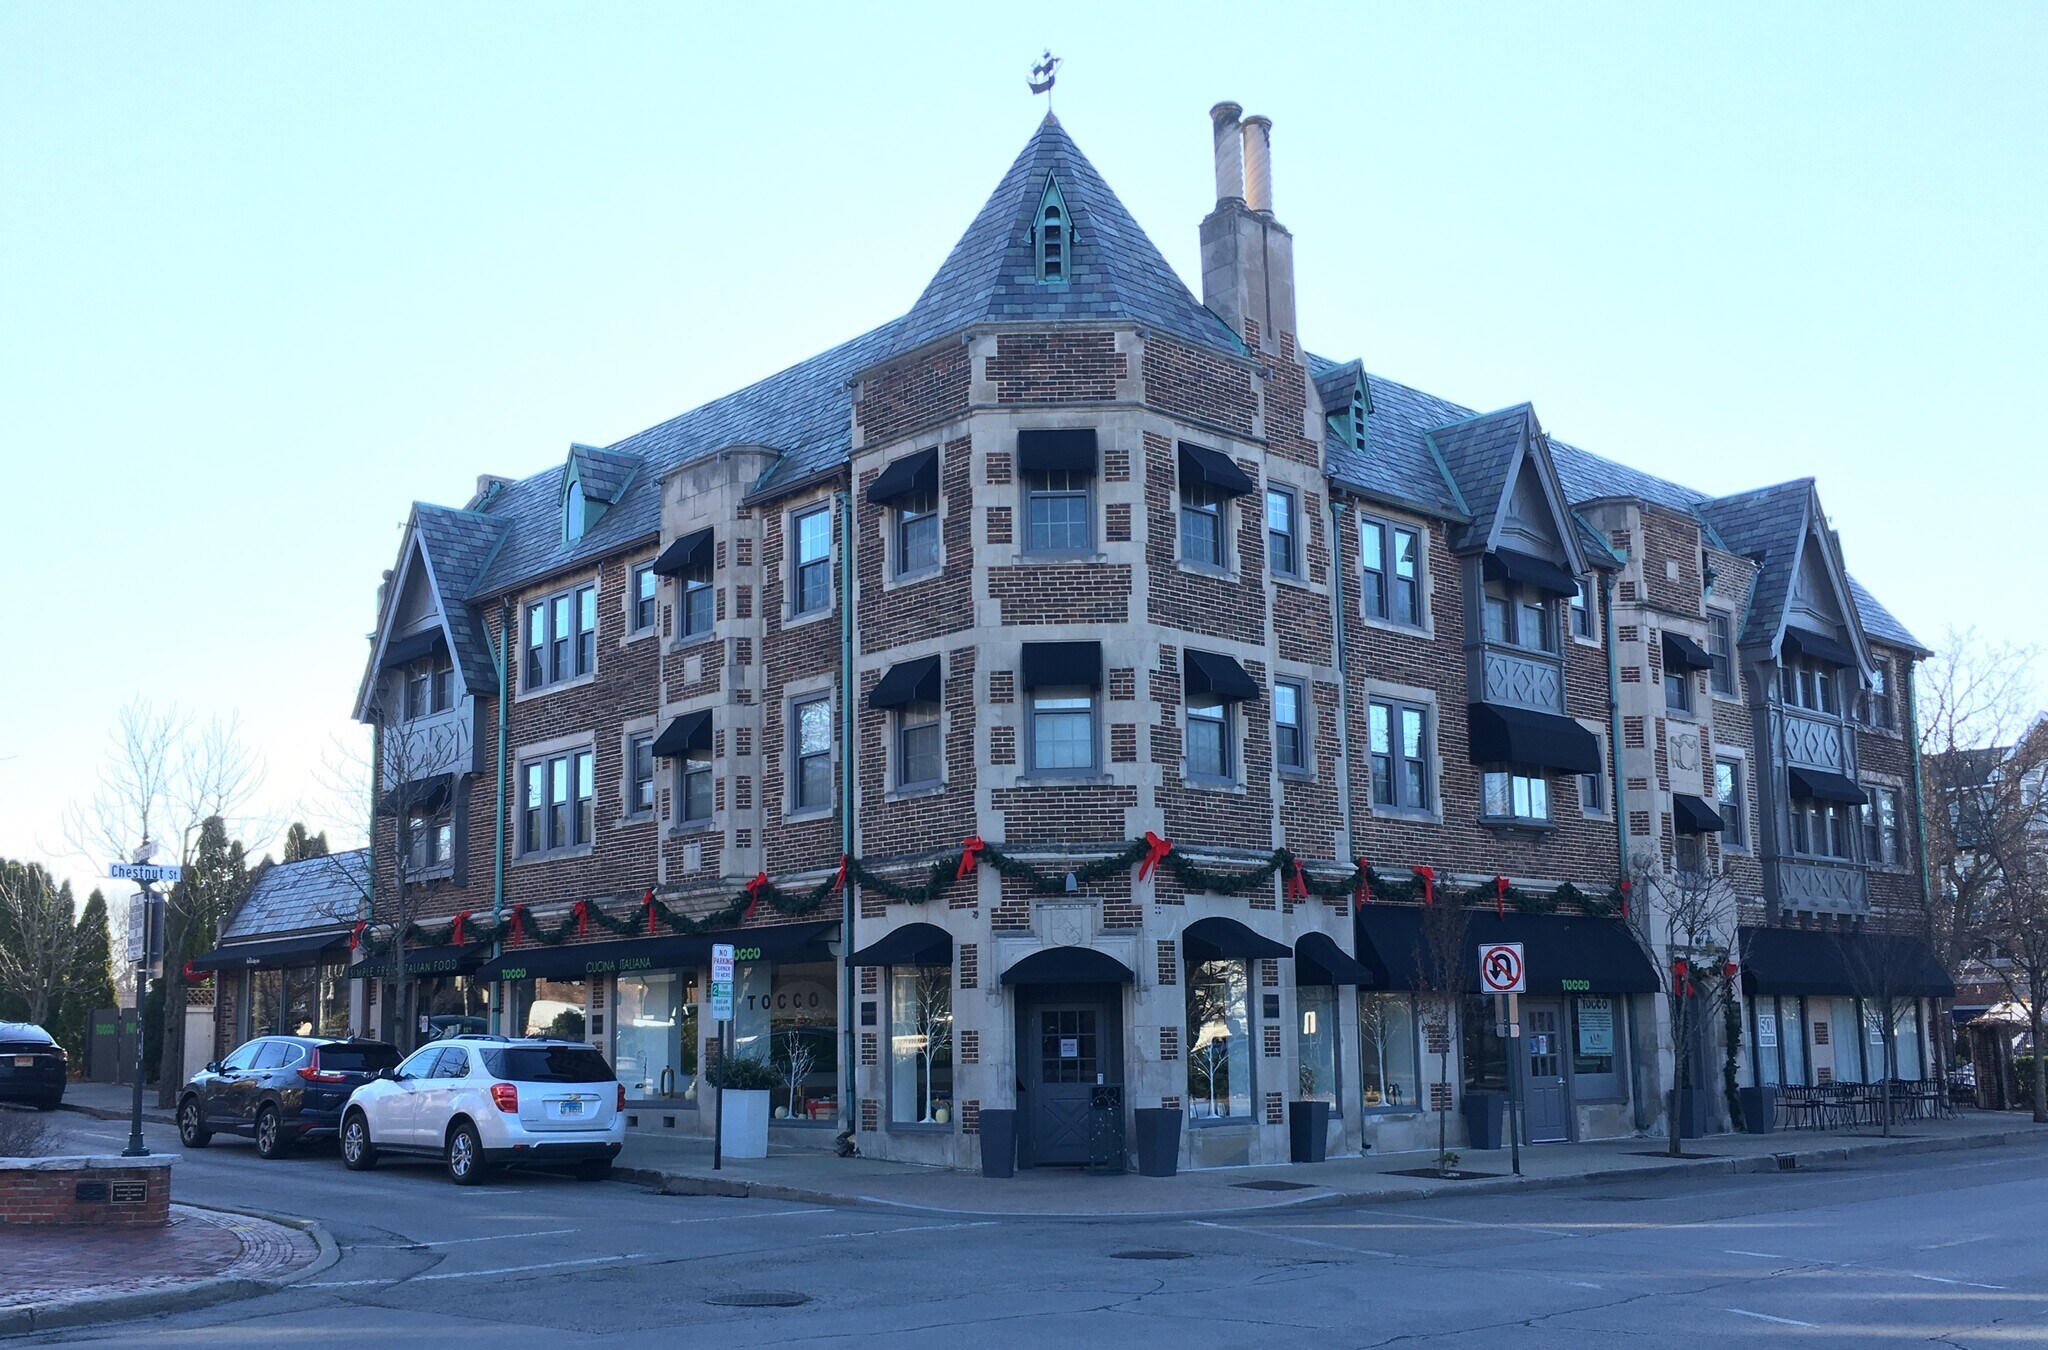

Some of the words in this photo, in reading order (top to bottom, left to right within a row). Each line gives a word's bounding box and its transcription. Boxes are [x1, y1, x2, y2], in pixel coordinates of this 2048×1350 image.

[111, 865, 164, 879] Chestnut
[168, 870, 177, 879] St
[719, 949, 728, 957] NO
[733, 947, 761, 960] OCCO
[350, 966, 374, 978] SIMPLE
[405, 961, 431, 974] TALIAN
[433, 959, 457, 971] FOOD
[586, 960, 615, 973] CUCINA
[619, 957, 652, 970] ITALIANA
[501, 968, 527, 980] TOCCO
[713, 985, 719, 995] 2
[1562, 979, 1590, 991] TOCCO
[747, 992, 819, 1011] TOCCO
[1582, 999, 1608, 1010] TOCCO
[1760, 1018, 1774, 1033] 501
